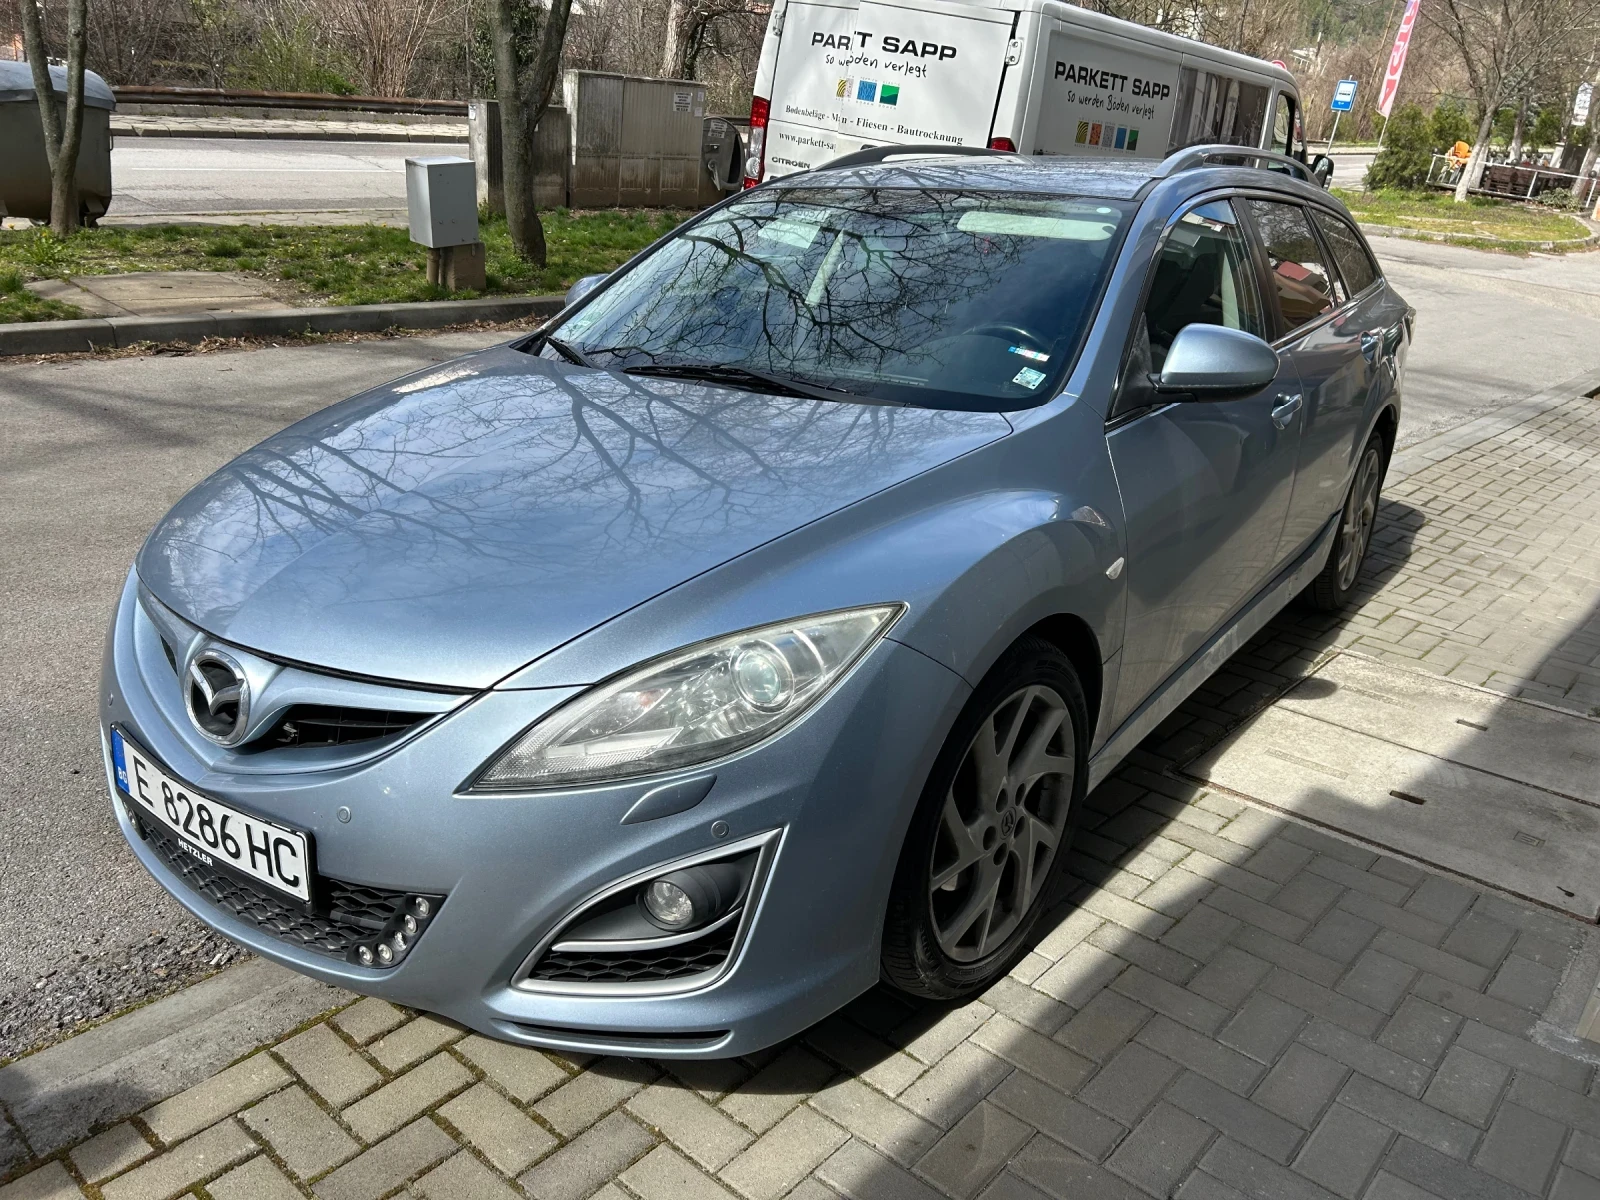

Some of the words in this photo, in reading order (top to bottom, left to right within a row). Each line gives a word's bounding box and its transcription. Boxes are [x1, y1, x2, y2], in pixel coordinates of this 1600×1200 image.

[882, 36, 957, 61] SAPP
[884, 61, 927, 78] verlegt
[1054, 61, 1128, 93] PARKETT
[1131, 78, 1171, 101] SAPP
[1078, 94, 1104, 108] werden
[1131, 104, 1155, 120] verlegt
[785, 105, 826, 121] Bodenbeläge
[856, 117, 888, 131] Fliesen
[896, 124, 964, 146] Bautrocknung
[132, 755, 154, 808] E
[161, 780, 241, 860] 8286
[245, 823, 300, 888] HC
[177, 838, 213, 866] HETZLER
